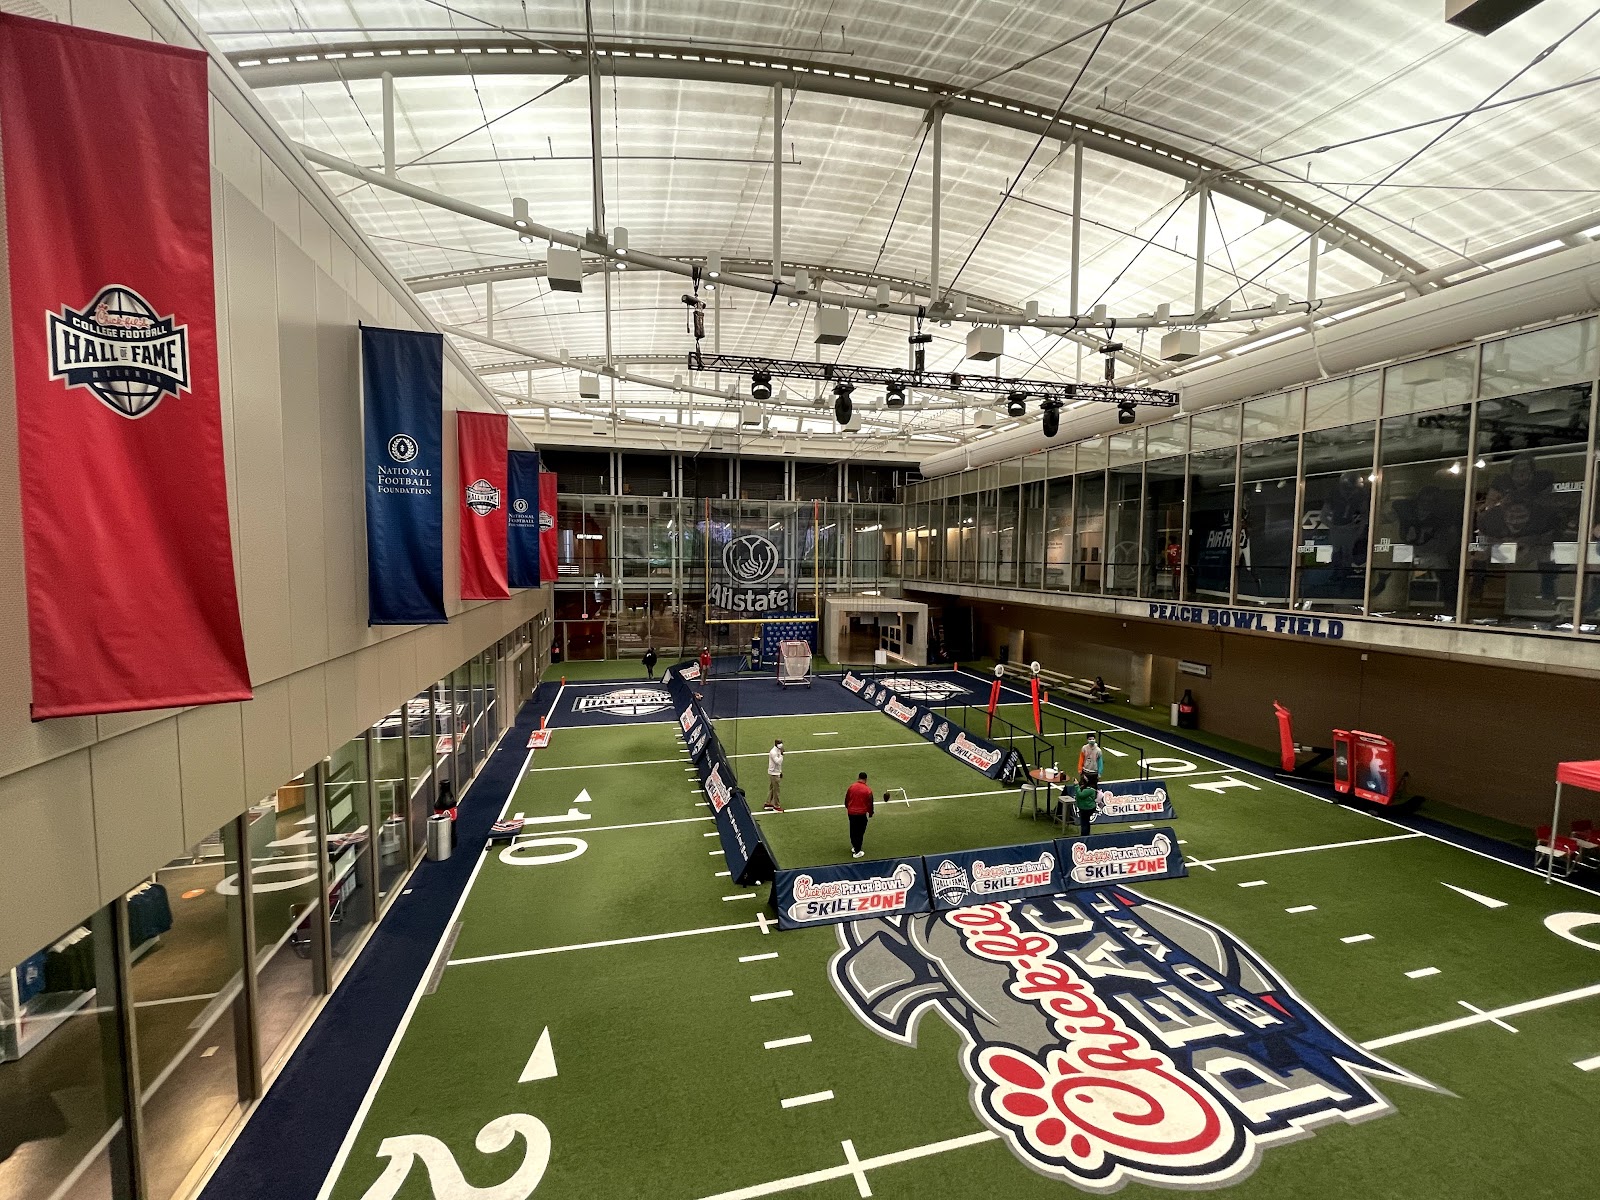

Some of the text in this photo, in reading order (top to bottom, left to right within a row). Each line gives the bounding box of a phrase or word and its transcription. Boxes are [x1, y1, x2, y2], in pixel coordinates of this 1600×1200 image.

[72, 317, 167, 339] COLLEGE FOOTBALL
[62, 329, 119, 364] HALL
[131, 339, 178, 373] FAME
[92, 369, 161, 383] ATLANTA
[377, 465, 431, 477] NATIONAL
[377, 475, 432, 487] FOOTBALL
[377, 486, 432, 495] FOUNDATION
[709, 583, 788, 611] Allstate
[1149, 603, 1344, 639] PEACH BOWL FIELD
[1112, 849, 1137, 860] PEACH
[1137, 846, 1162, 857] BOWL
[1006, 866, 1026, 875] PEACH
[1026, 862, 1048, 872] BOWL
[841, 882, 873, 895] PEACH
[873, 879, 904, 891] BOWL
[1091, 892, 1284, 1029] BOWL
[1021, 894, 1352, 1123] PEAC
[953, 902, 1221, 1155] Chick-fil
